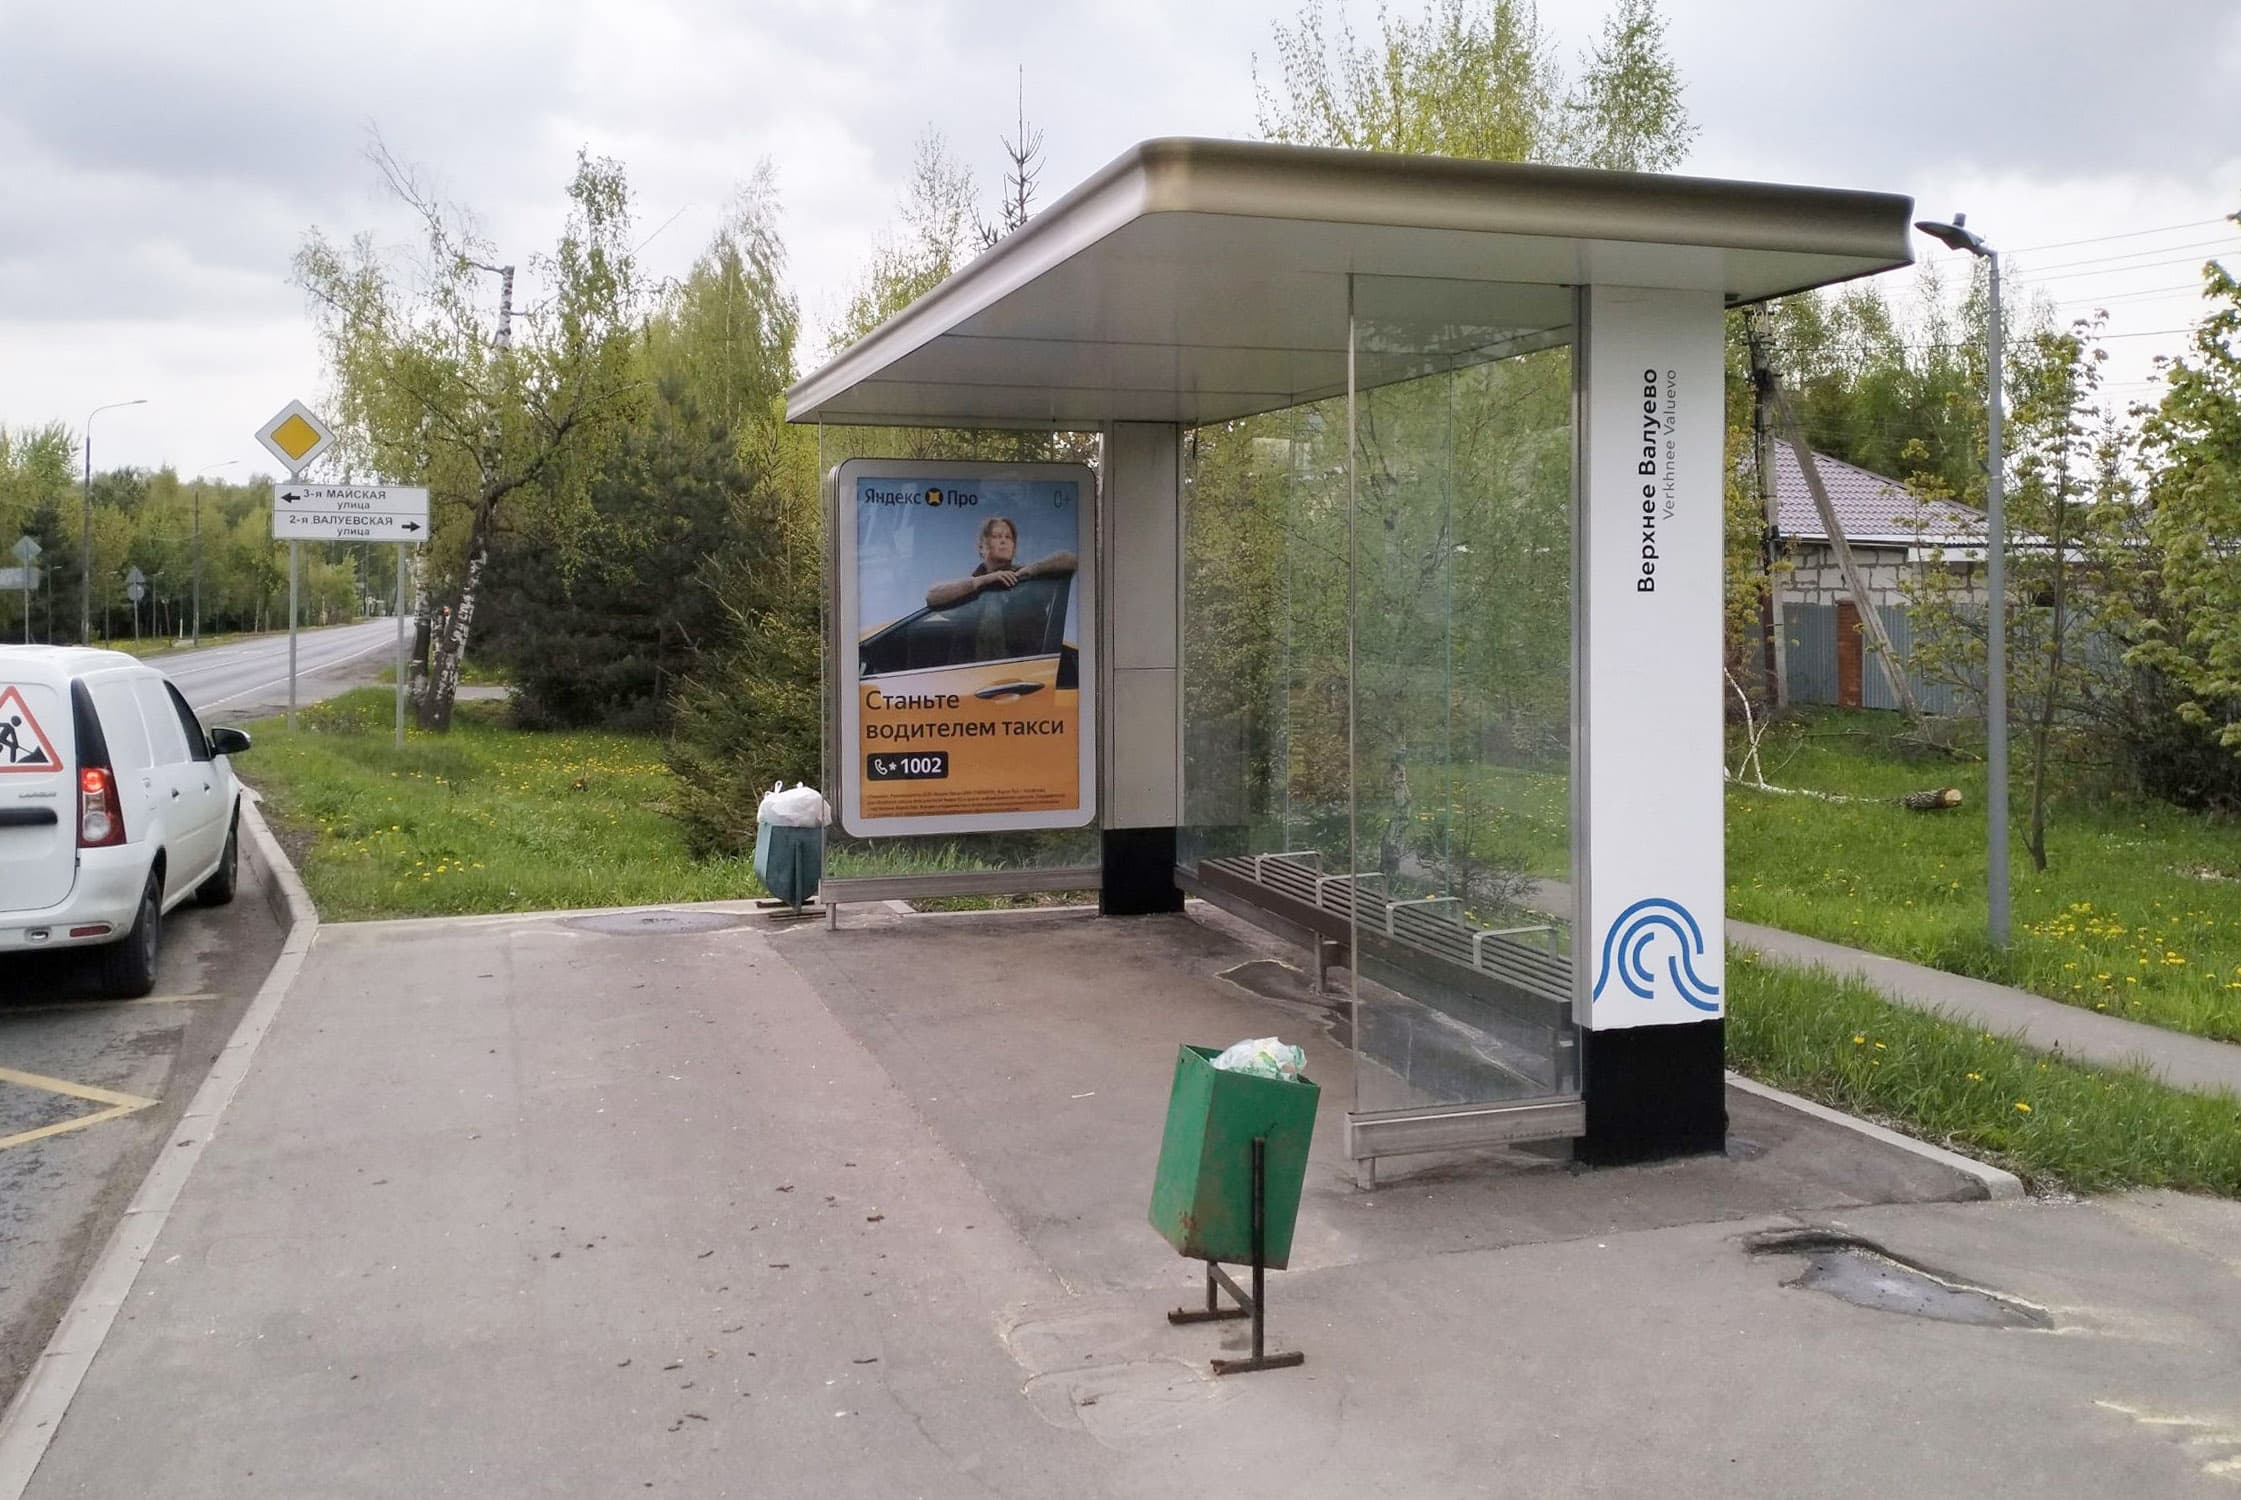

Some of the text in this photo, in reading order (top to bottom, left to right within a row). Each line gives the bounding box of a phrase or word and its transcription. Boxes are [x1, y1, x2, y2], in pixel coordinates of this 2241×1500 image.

[1662, 369, 1677, 521] Verkhnee Valuevo
[1637, 368, 1661, 592] Верхнее Валуево
[303, 487, 387, 500] 3-я МАЙСКАЯ
[864, 487, 979, 508] Яндекс Про
[1053, 490, 1071, 509] 0+
[337, 501, 370, 511] улица
[289, 514, 394, 526] 2-я ВАЛУЕВСКАЯ
[337, 527, 370, 537] улица
[865, 690, 960, 711] Станьте
[866, 719, 1065, 742] водителем такси
